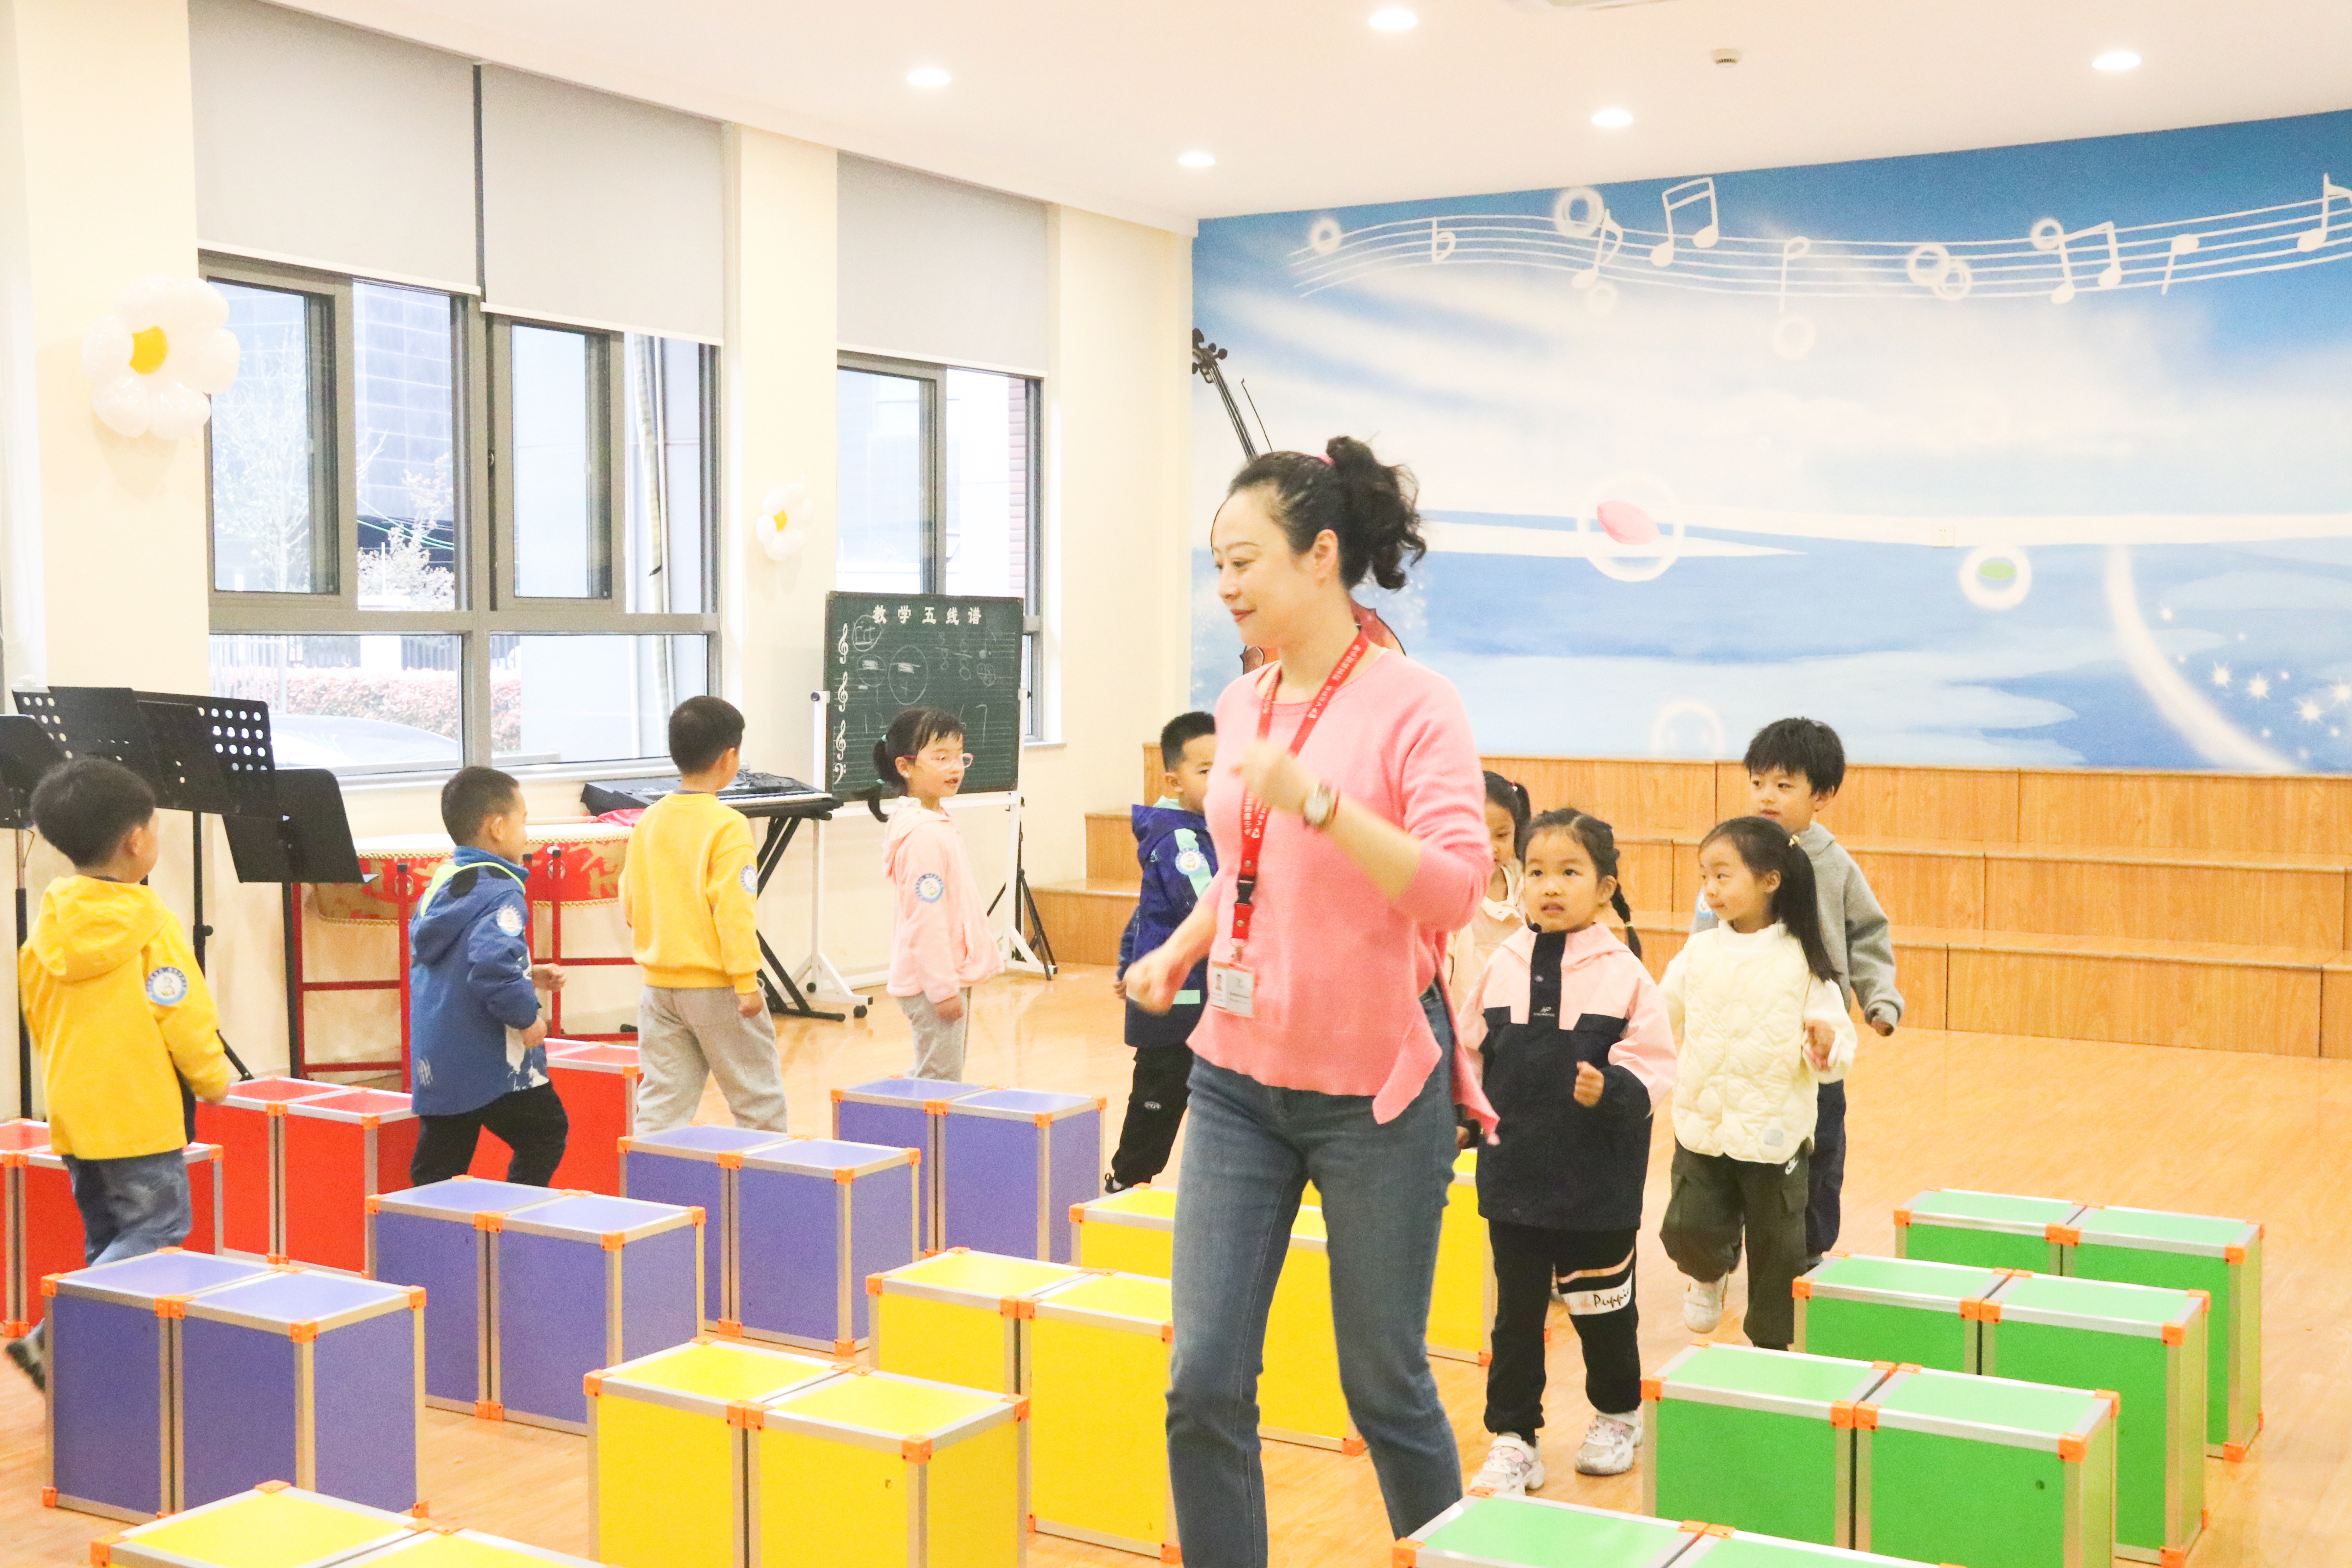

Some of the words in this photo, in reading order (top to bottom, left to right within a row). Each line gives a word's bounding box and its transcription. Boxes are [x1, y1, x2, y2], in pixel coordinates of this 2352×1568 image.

[872, 604, 981, 625] 教学五线谱
